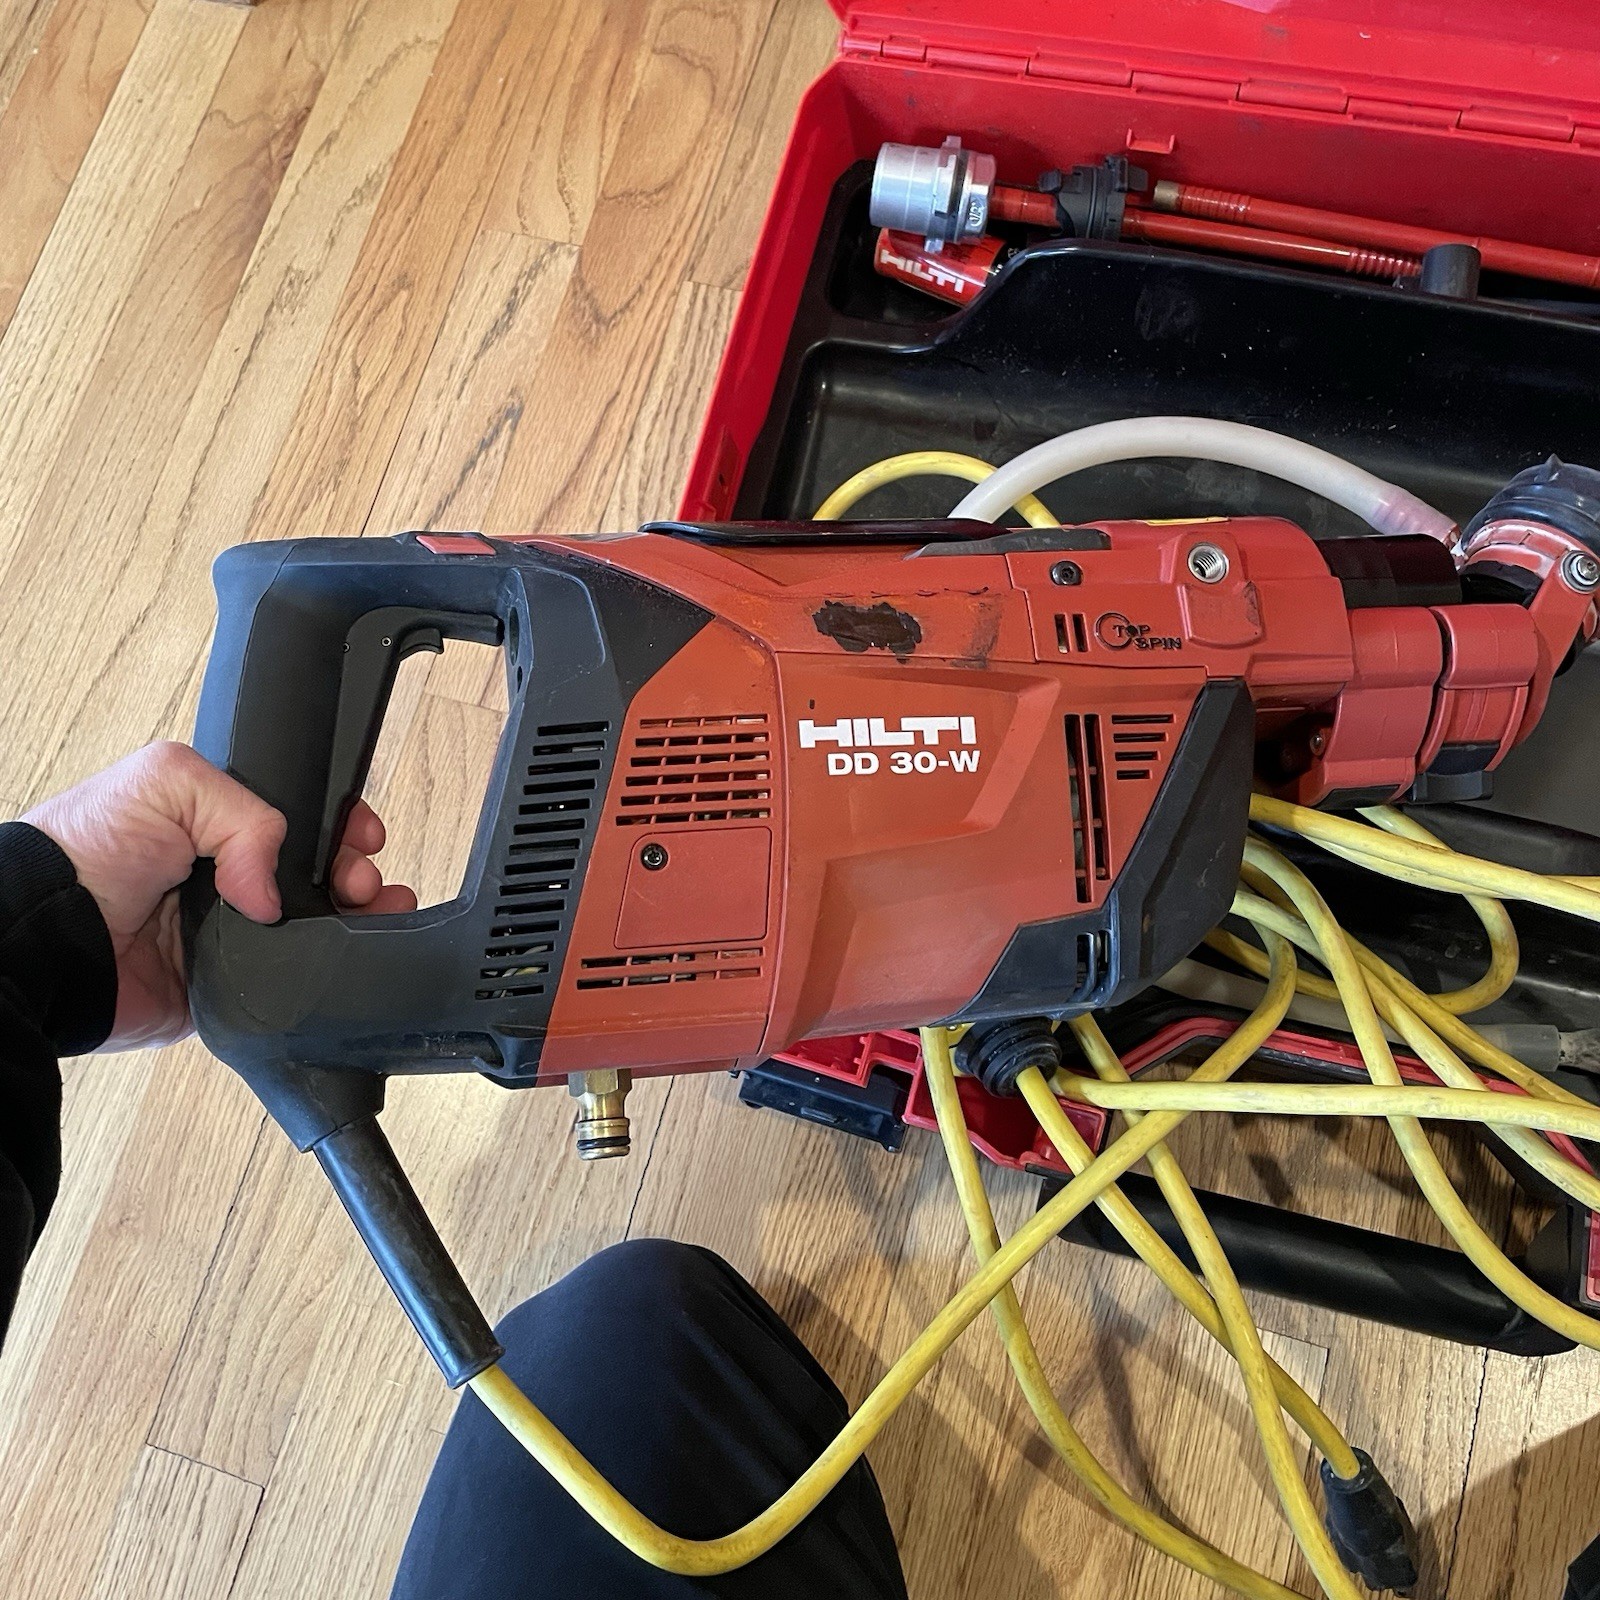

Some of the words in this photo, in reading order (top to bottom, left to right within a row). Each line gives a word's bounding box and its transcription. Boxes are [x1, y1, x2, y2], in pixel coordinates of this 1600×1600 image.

[880, 249, 964, 293] HILTI
[1134, 637, 1182, 650] SPIN
[798, 716, 977, 749] HILTI
[827, 752, 880, 776] DD
[889, 750, 981, 774] 30-W
